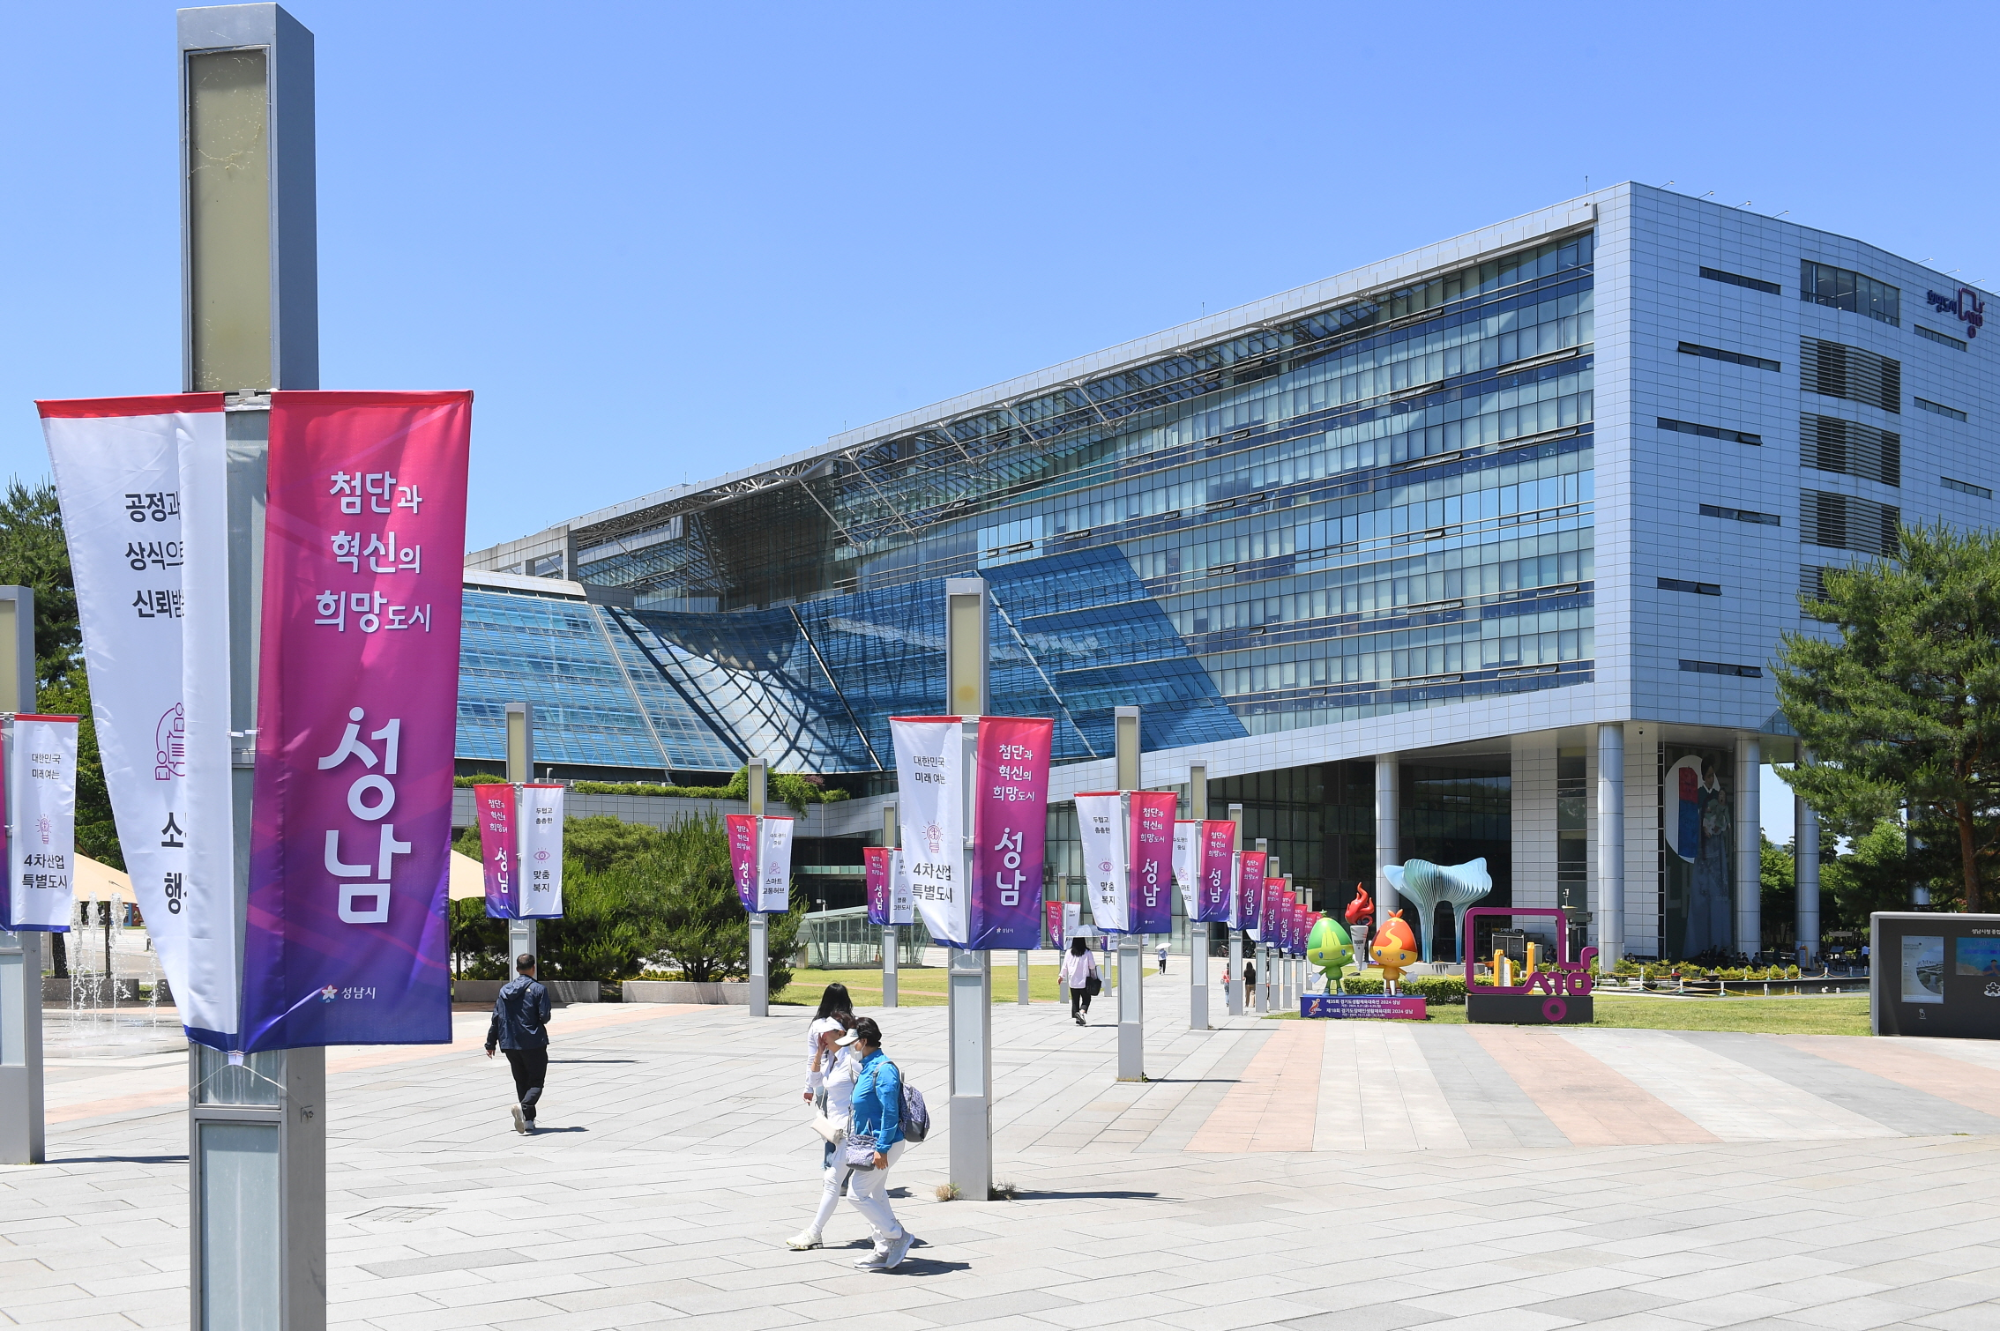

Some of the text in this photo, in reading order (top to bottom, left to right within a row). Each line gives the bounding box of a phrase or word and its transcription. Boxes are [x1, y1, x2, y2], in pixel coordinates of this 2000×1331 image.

[329, 471, 423, 514] 첨단과
[125, 491, 181, 523] 공정과
[330, 530, 421, 574] 혁신의
[132, 589, 184, 619] 신뢰받
[314, 589, 431, 633] 희망도시
[31, 753, 62, 764] 대한민국
[913, 755, 945, 768] 대한민국
[999, 744, 1033, 761] 첨단과
[915, 772, 946, 785] 미래 여는
[998, 765, 1032, 781] 혁신의
[992, 785, 1036, 802] 희망도시
[317, 706, 412, 924] 성남
[1142, 807, 1164, 818] 첨단과
[161, 812, 187, 848] 소
[1142, 820, 1163, 830] 혁신의
[1140, 833, 1165, 843] 희망도시
[494, 847, 509, 894] 성남
[533, 870, 551, 880] 맞춤
[994, 827, 1027, 906] 성남
[21, 873, 68, 890] 특별도시
[739, 860, 750, 895] 성남
[1100, 881, 1115, 892] 맞춤
[1141, 858, 1161, 907] 성남
[1209, 868, 1223, 904] 성남
[164, 872, 188, 915] 행
[532, 883, 550, 893] 복지
[911, 883, 953, 903] 특별도시
[1101, 895, 1116, 905] 복지
[1244, 888, 1255, 916] 성남
[341, 986, 376, 1000] 성남시
